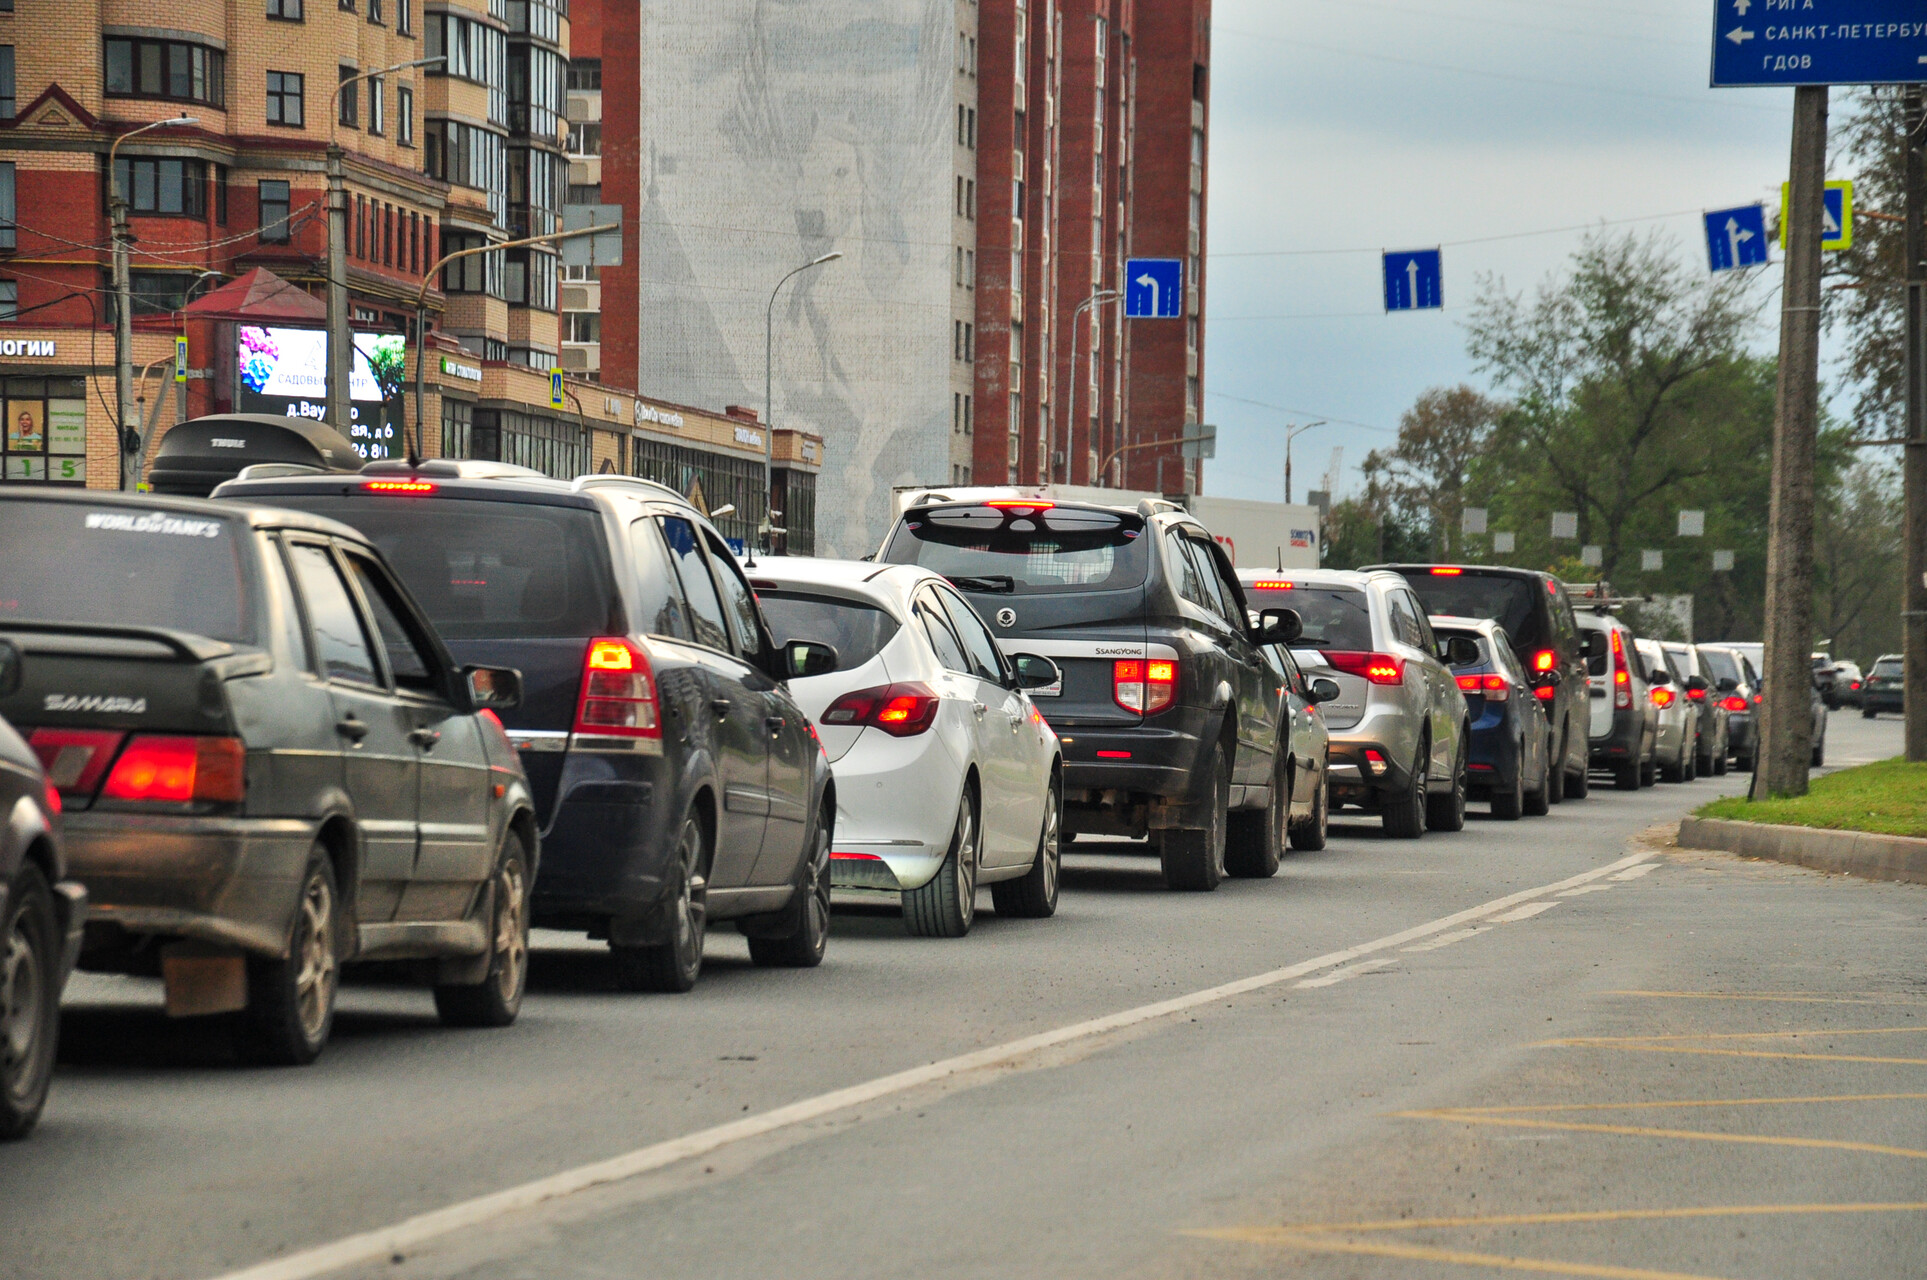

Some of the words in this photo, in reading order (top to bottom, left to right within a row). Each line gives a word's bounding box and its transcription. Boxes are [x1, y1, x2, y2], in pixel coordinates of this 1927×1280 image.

[1766, 0, 1814, 10] РИГА
[1765, 23, 1927, 41] САНКТ-ПЕТЕРБУ
[1762, 55, 1812, 72] ГДОВ
[210, 438, 246, 449] THULE
[61, 460, 76, 478] 5
[44, 694, 146, 713] SAMARA
